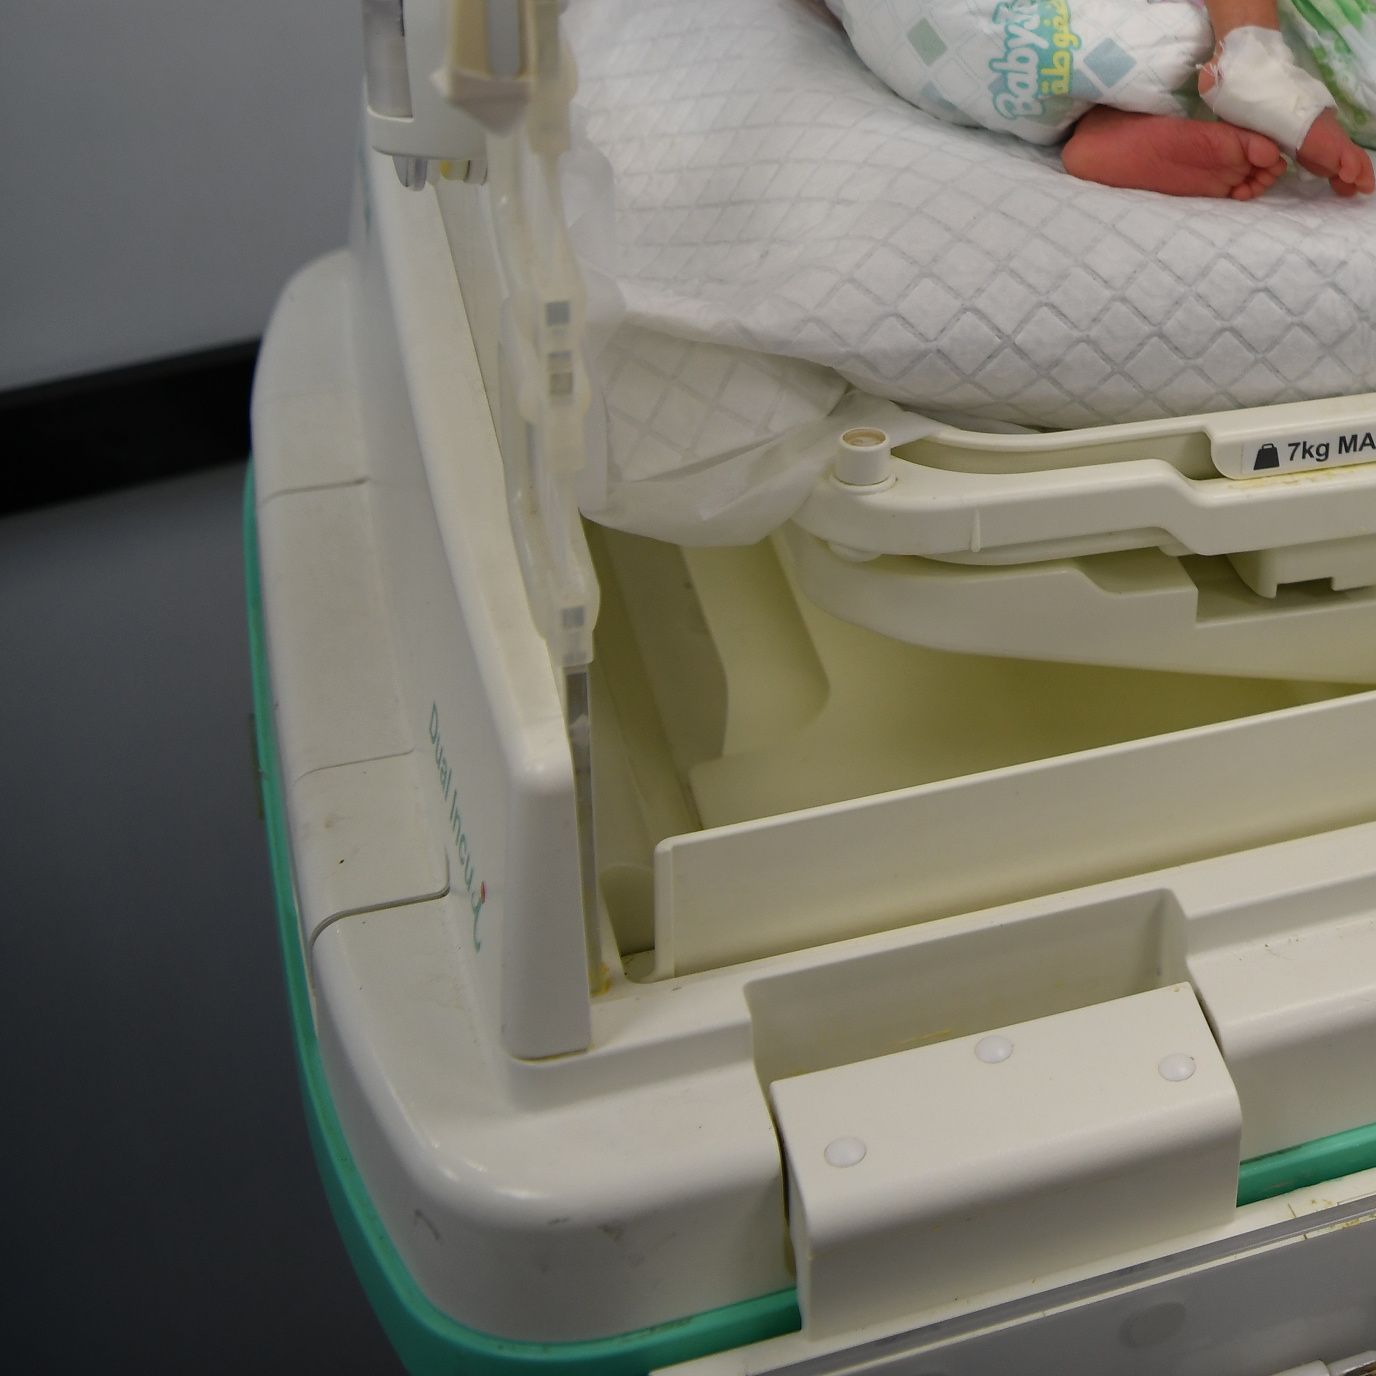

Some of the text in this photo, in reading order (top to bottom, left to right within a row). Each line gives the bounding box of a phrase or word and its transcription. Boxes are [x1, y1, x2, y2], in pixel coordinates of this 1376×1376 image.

[1288, 440, 1330, 462] 7kg
[429, 700, 452, 802] Dual
[450, 789, 474, 893] Incu
